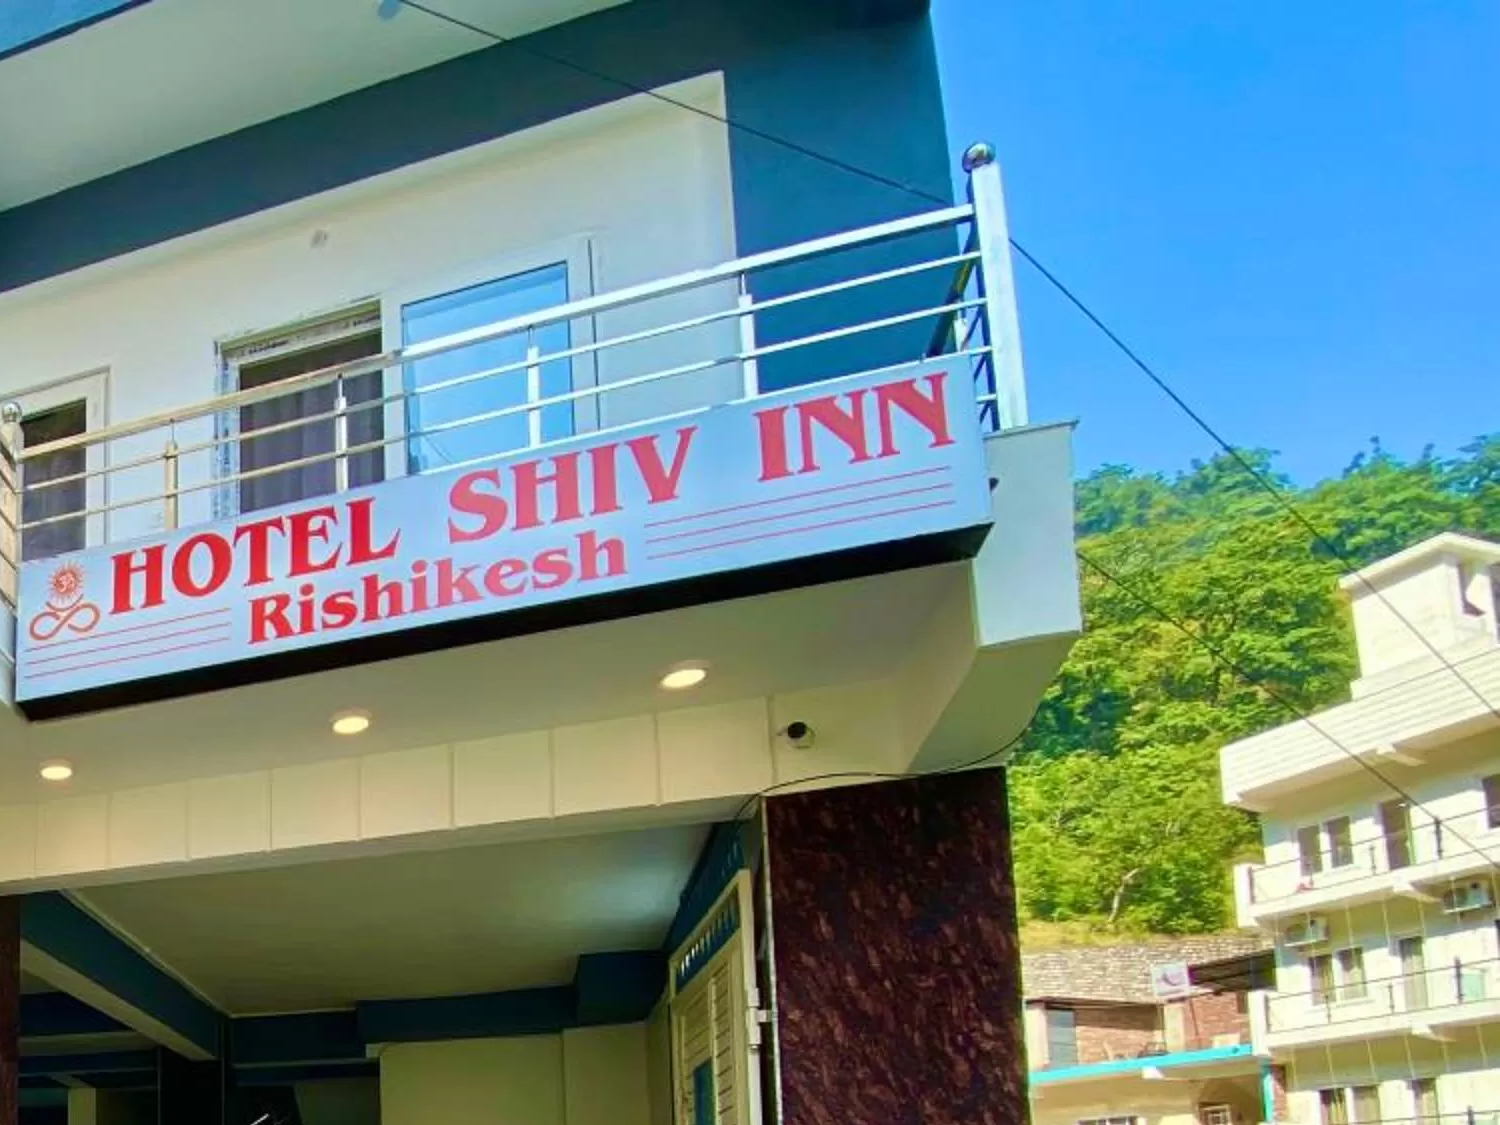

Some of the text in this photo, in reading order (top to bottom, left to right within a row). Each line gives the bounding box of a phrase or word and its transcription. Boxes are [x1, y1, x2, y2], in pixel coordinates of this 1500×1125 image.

[109, 372, 955, 616] HOTEL SHIV INN
[248, 532, 626, 646] Rishikesh
